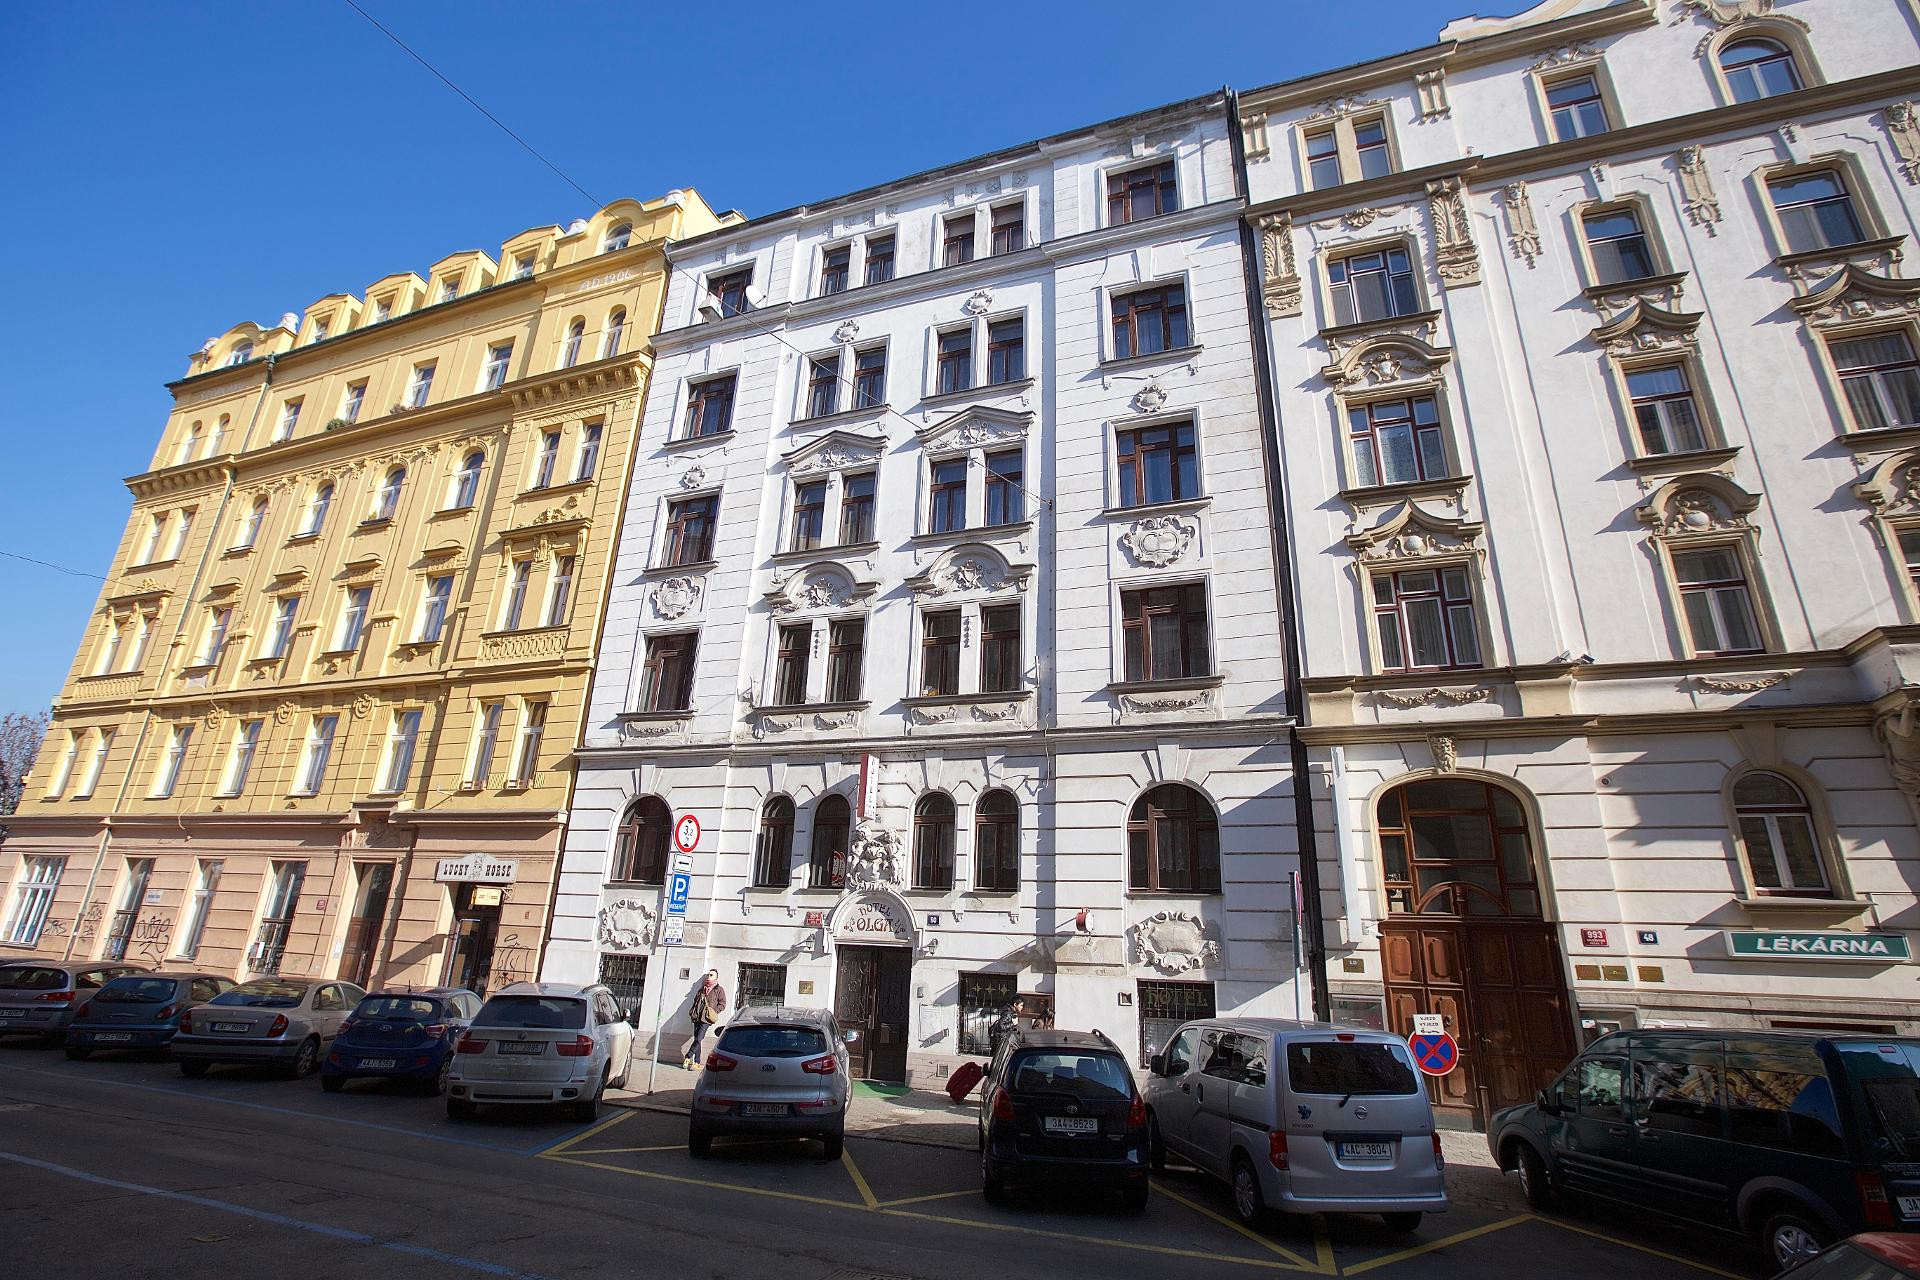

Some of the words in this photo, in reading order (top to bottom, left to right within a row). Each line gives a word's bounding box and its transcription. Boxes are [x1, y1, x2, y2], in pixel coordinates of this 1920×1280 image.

[443, 863, 470, 876] LUCKY
[485, 864, 512, 877] HORSE
[673, 877, 687, 901] P
[858, 902, 891, 917] HOTEL
[856, 917, 894, 933] OLGA
[1587, 930, 1604, 939] 993
[1643, 933, 1654, 942] 48
[1755, 935, 1890, 954] LÉKÁRNA
[1052, 1118, 1067, 1128] 3A4
[1073, 1119, 1094, 1129] 8529
[1344, 1143, 1361, 1155] 4AC
[1366, 1143, 1387, 1155] 3804
